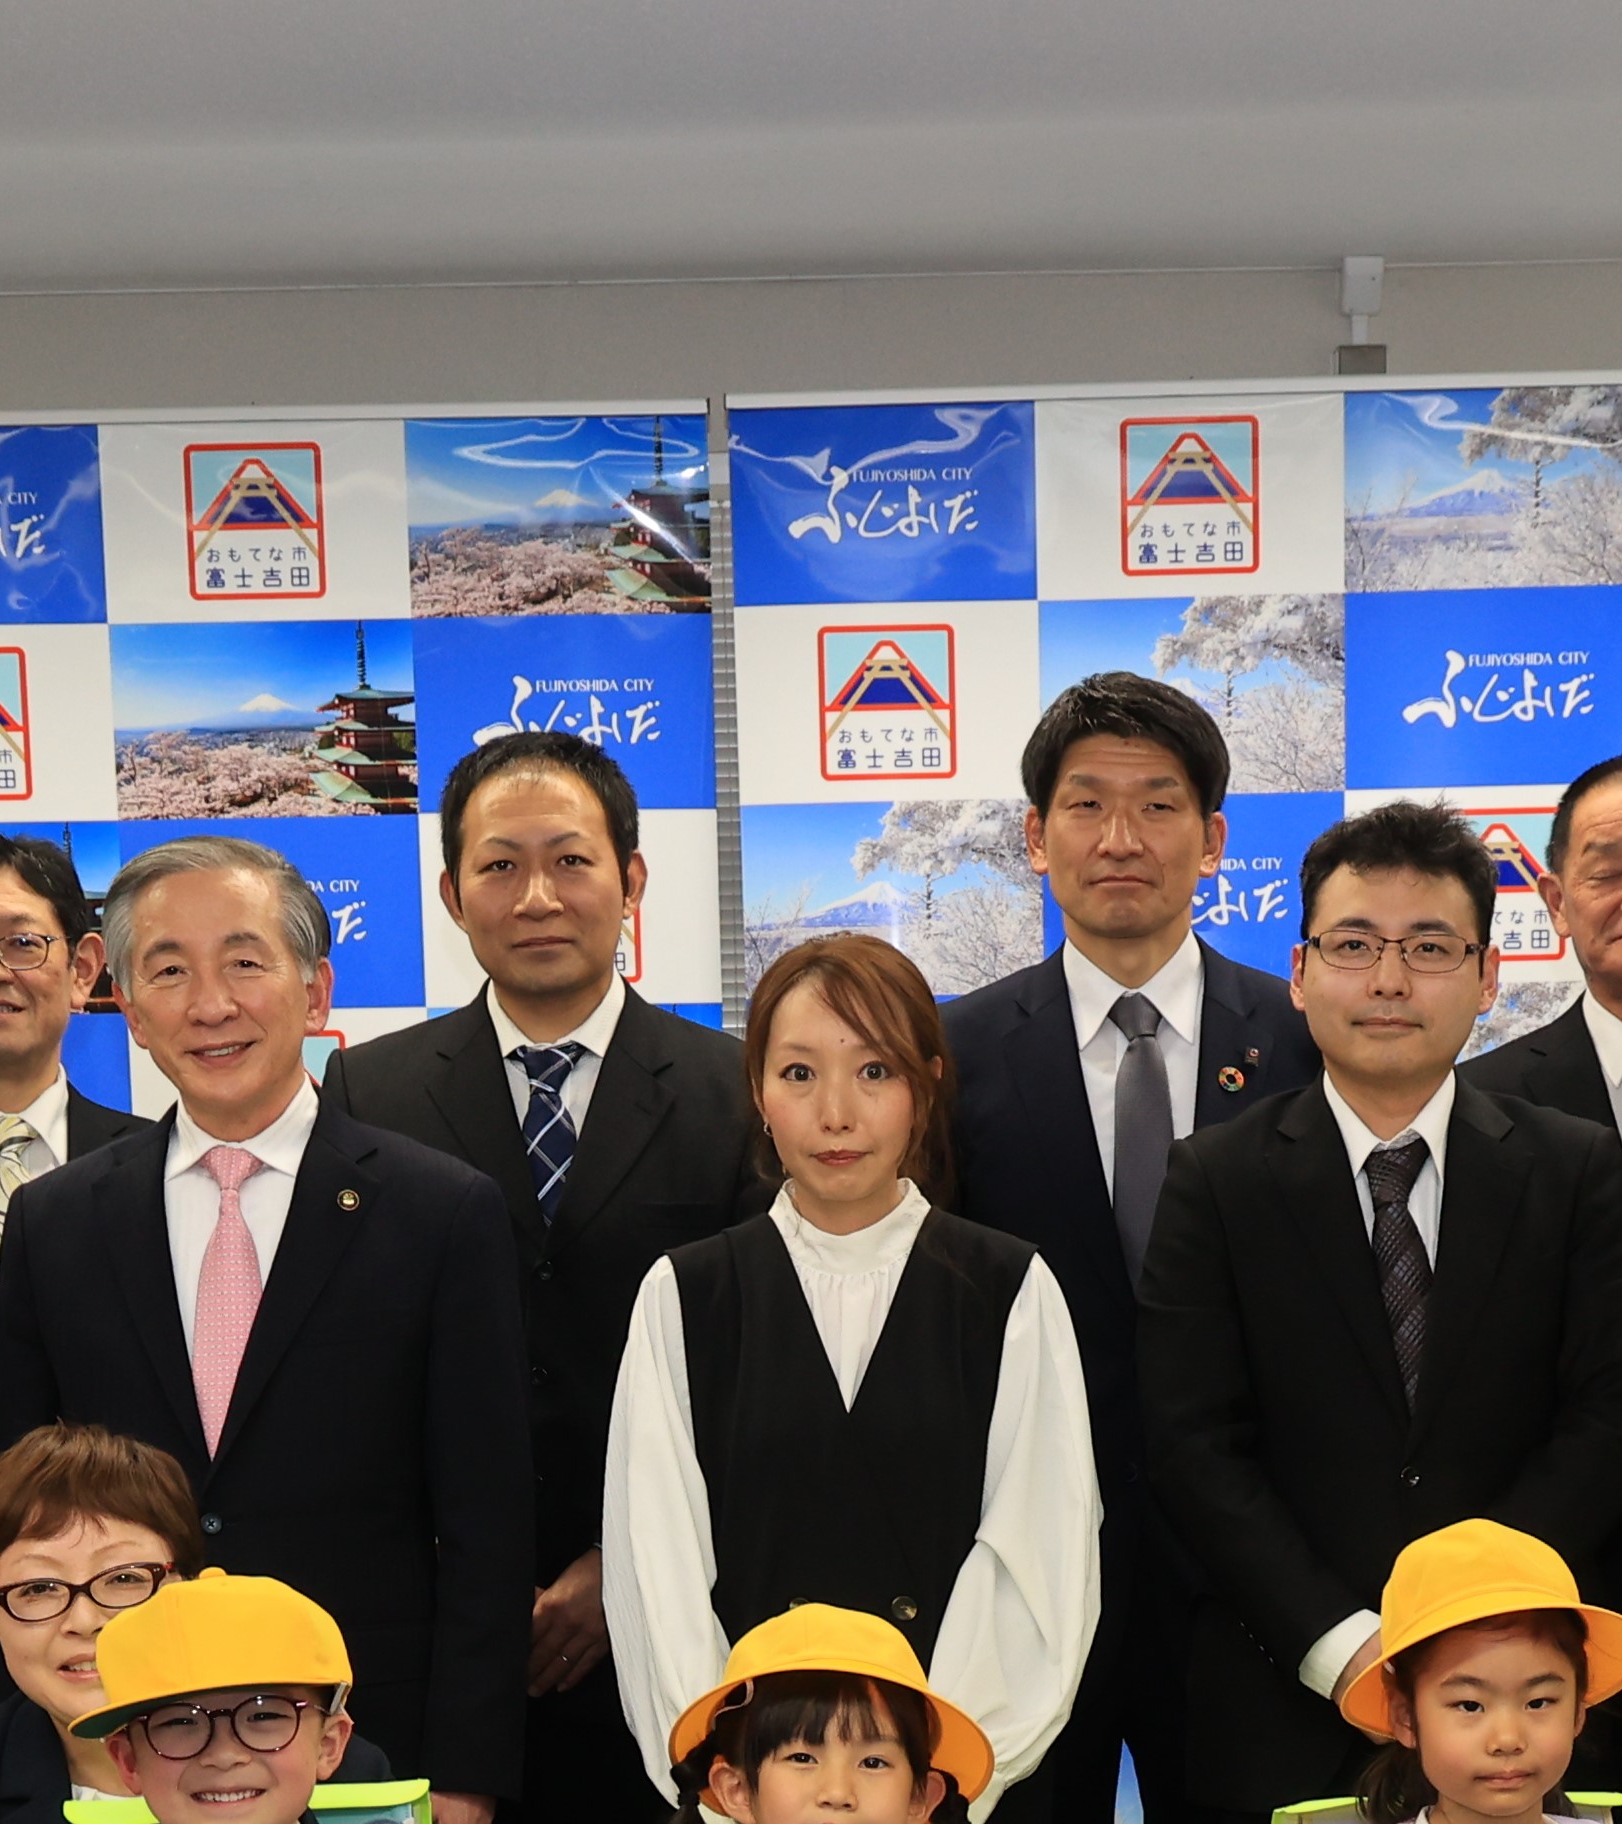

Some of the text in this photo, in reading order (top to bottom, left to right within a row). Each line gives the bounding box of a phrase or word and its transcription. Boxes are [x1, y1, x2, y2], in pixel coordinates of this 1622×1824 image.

[942, 467, 973, 481] CITY
[8, 491, 37, 505] CITY
[1140, 520, 1241, 538] おもてな市
[207, 546, 307, 563] おもてな市
[1139, 542, 1243, 564] 富士吉田
[206, 566, 310, 588] 富士吉田
[1468, 651, 1589, 667] FUJIYOSHIDA CITY
[535, 678, 654, 693] FUJIYOSHIDA CITY
[839, 727, 938, 743] おもてな市
[837, 747, 941, 769] 富士吉田
[1252, 857, 1283, 871] CITY
[329, 879, 360, 893] CITY
[1493, 909, 1548, 925] てな市
[1503, 929, 1550, 950] 吉田
